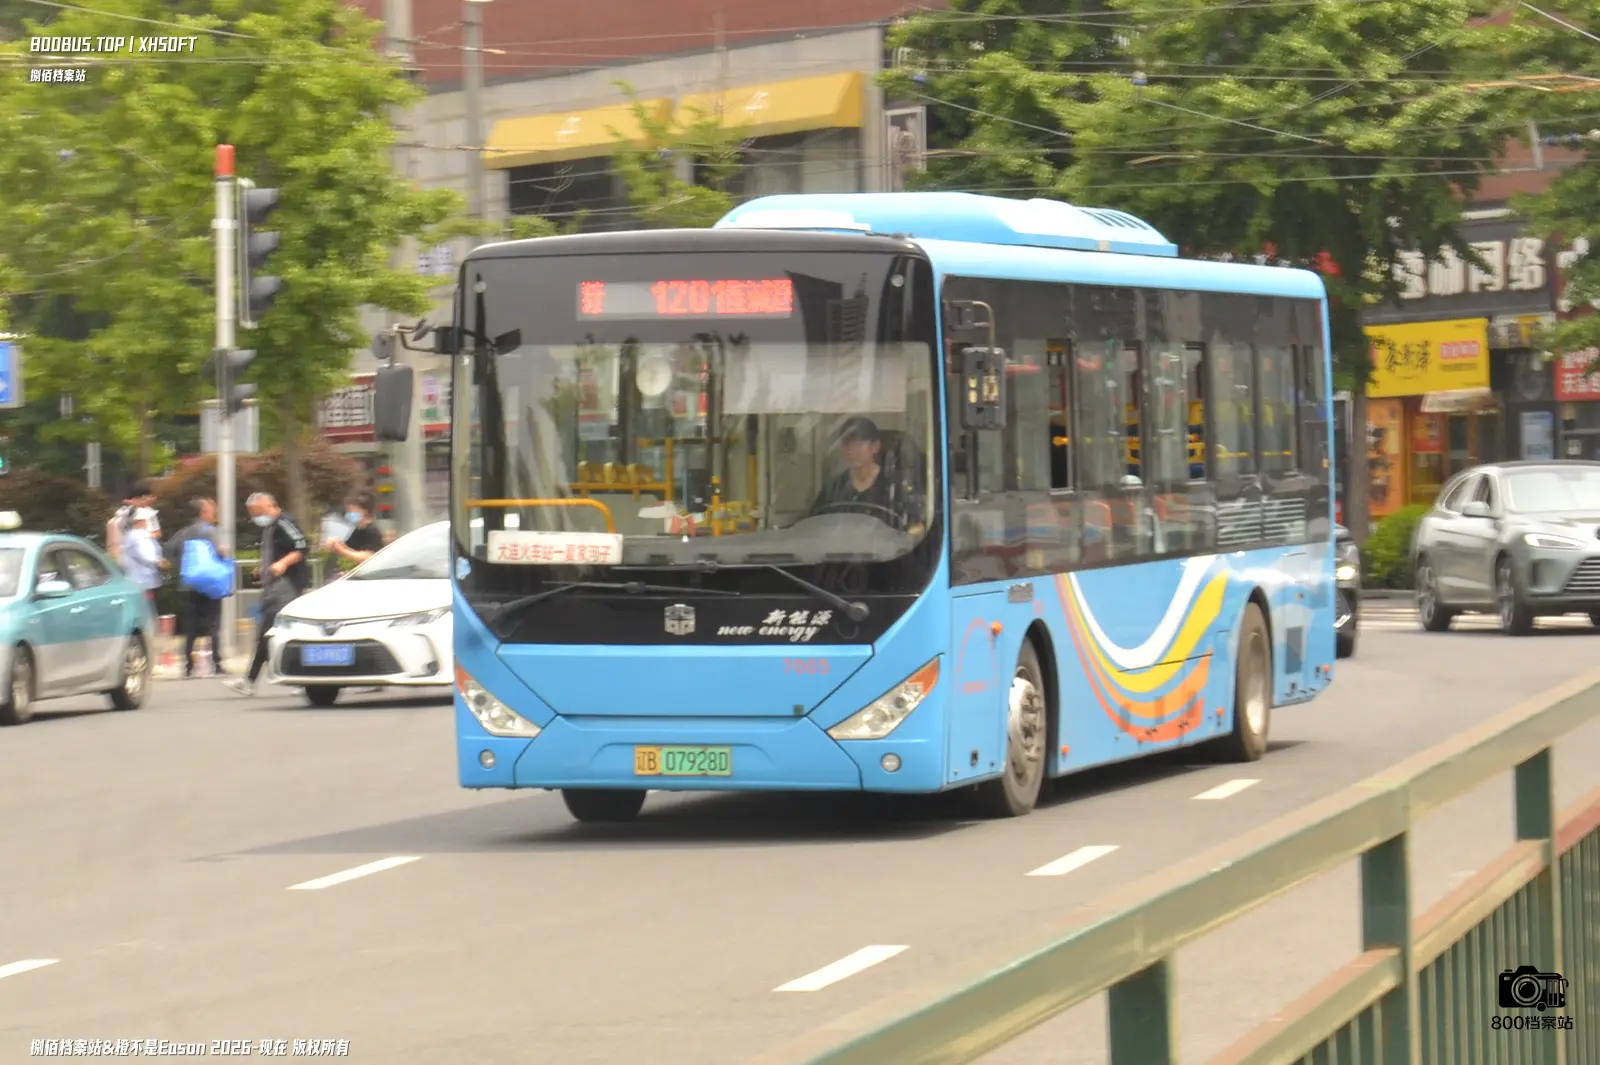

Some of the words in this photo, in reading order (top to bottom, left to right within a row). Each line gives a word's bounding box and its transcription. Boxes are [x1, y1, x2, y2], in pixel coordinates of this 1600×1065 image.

[716, 625, 757, 636] new
[758, 625, 820, 642] energy
[782, 657, 831, 675] 7005
